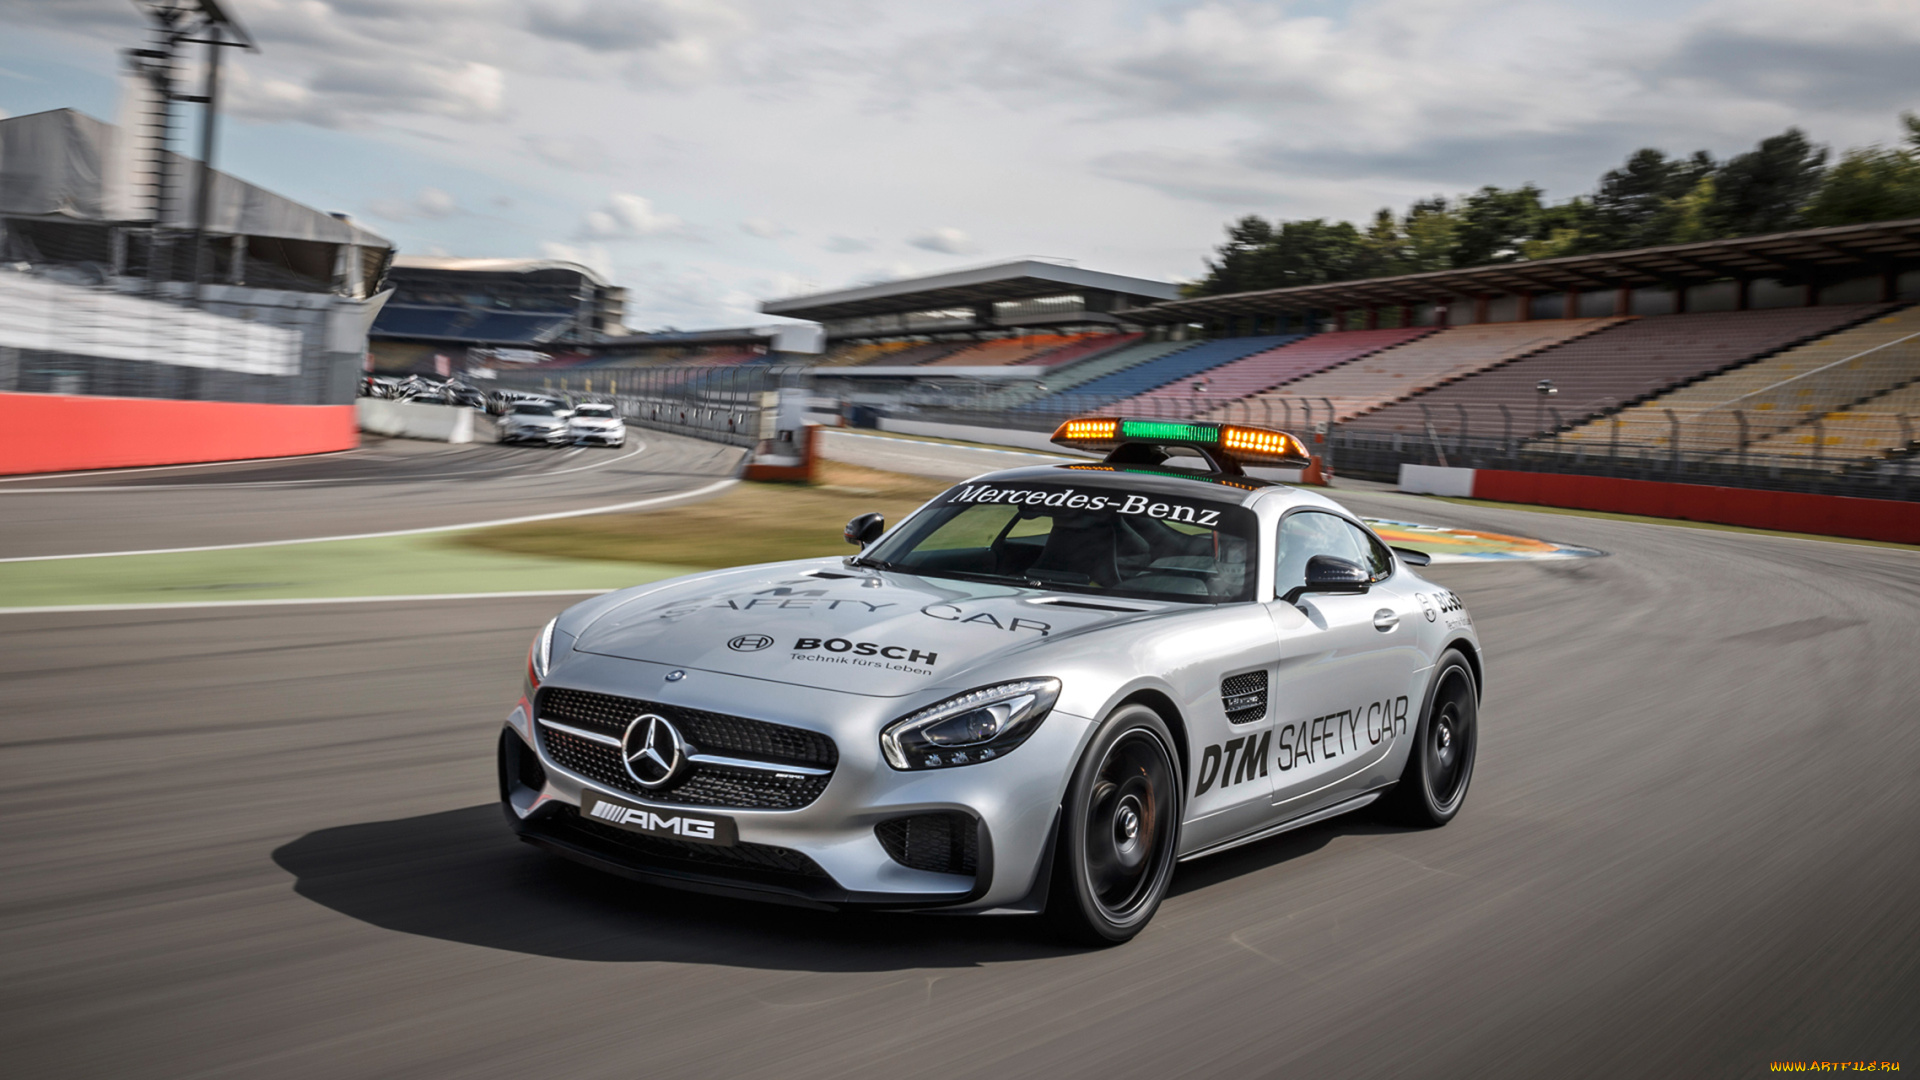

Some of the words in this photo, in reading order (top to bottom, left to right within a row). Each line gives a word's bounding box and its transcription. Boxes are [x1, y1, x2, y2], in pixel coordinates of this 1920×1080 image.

[947, 484, 1222, 527] Mercedes-Benz
[920, 604, 1052, 637] CAR
[789, 652, 849, 665] Technik
[852, 657, 882, 669] fürs
[885, 662, 933, 676] Leben
[793, 637, 938, 666] BOSCH
[1194, 729, 1273, 798] DTM
[1277, 706, 1362, 772] SAFETY
[1367, 695, 1409, 746] CAR
[619, 806, 716, 840] AMG
